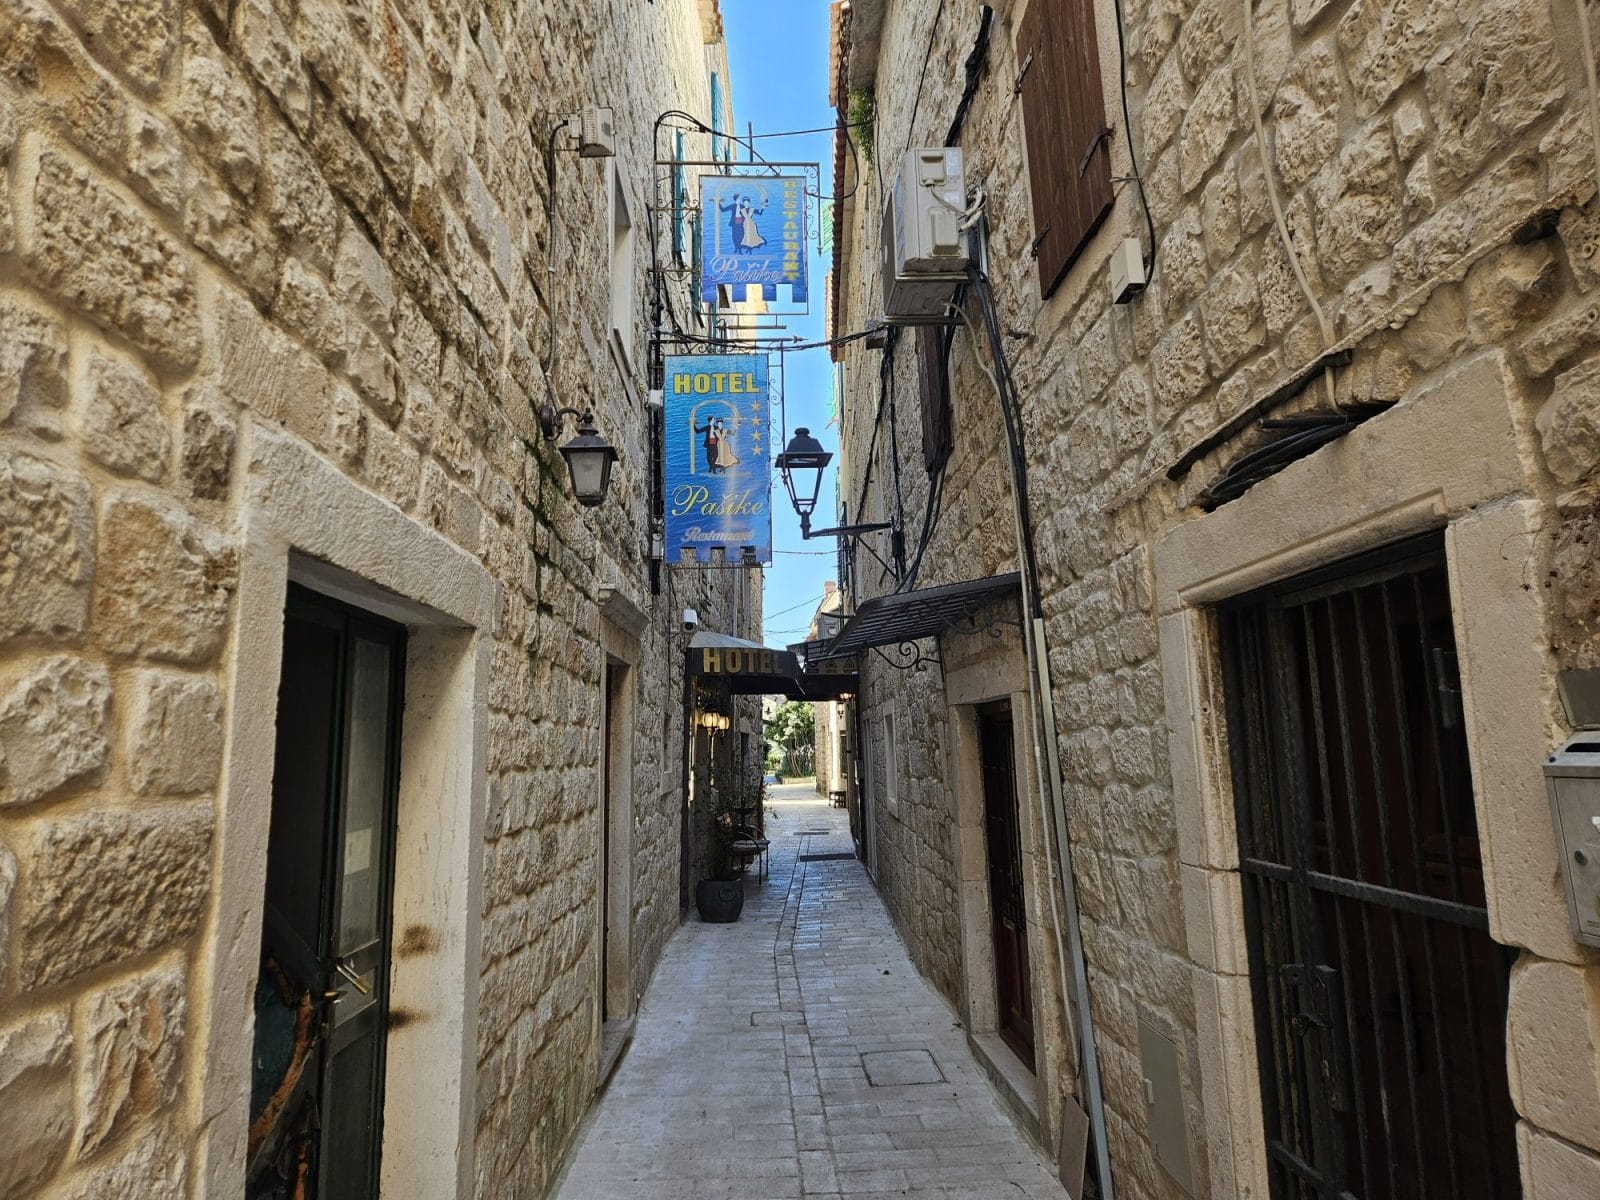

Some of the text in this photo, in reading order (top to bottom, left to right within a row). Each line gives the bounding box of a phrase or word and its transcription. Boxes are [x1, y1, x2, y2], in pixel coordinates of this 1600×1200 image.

[782, 180, 800, 281] RESTAURANT
[673, 372, 760, 394] HOTEL
[671, 484, 764, 517] Pašike
[703, 647, 784, 674] HOTEL
